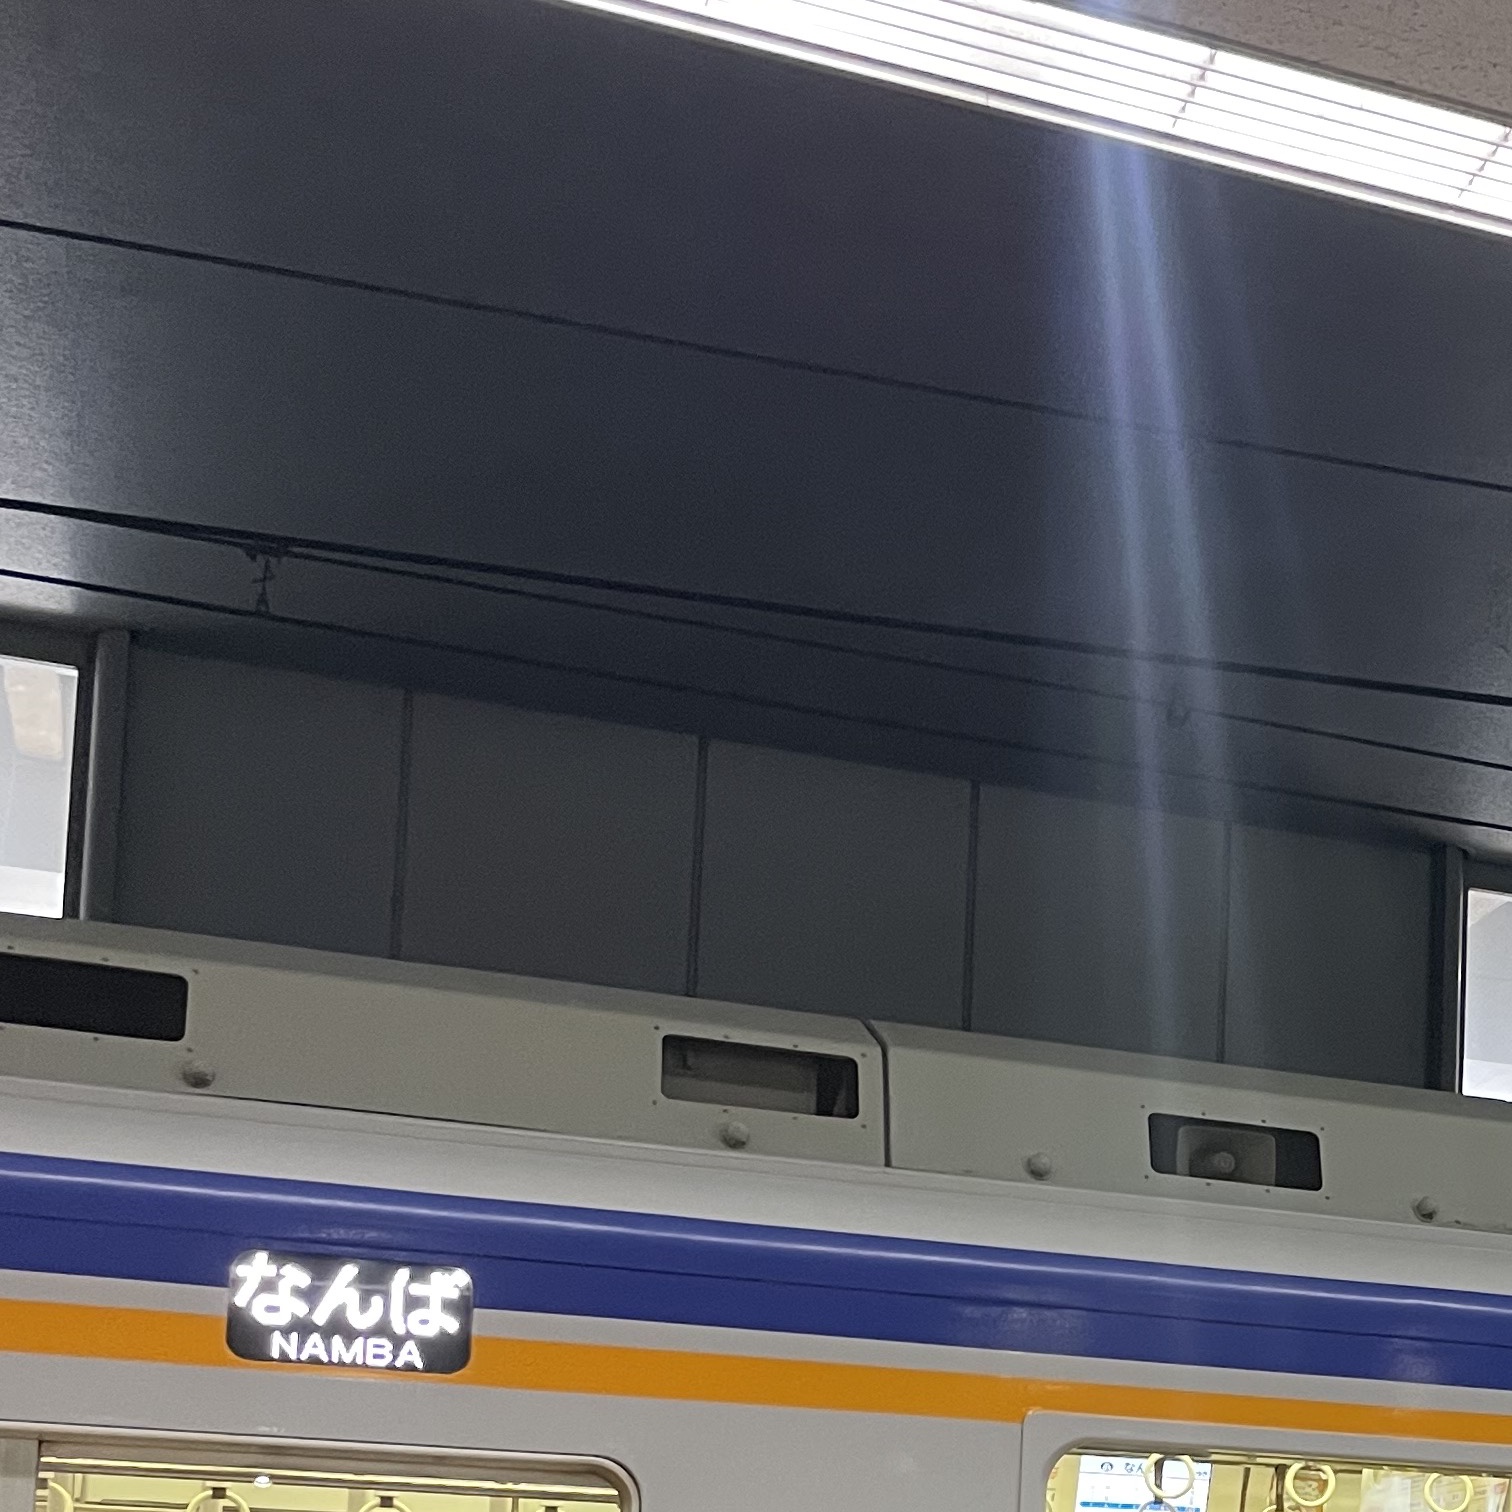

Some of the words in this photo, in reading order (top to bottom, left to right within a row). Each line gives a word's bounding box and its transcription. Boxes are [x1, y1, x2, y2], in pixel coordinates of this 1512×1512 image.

[233, 1252, 471, 1337] なんば
[270, 1330, 424, 1370] NAMBA
